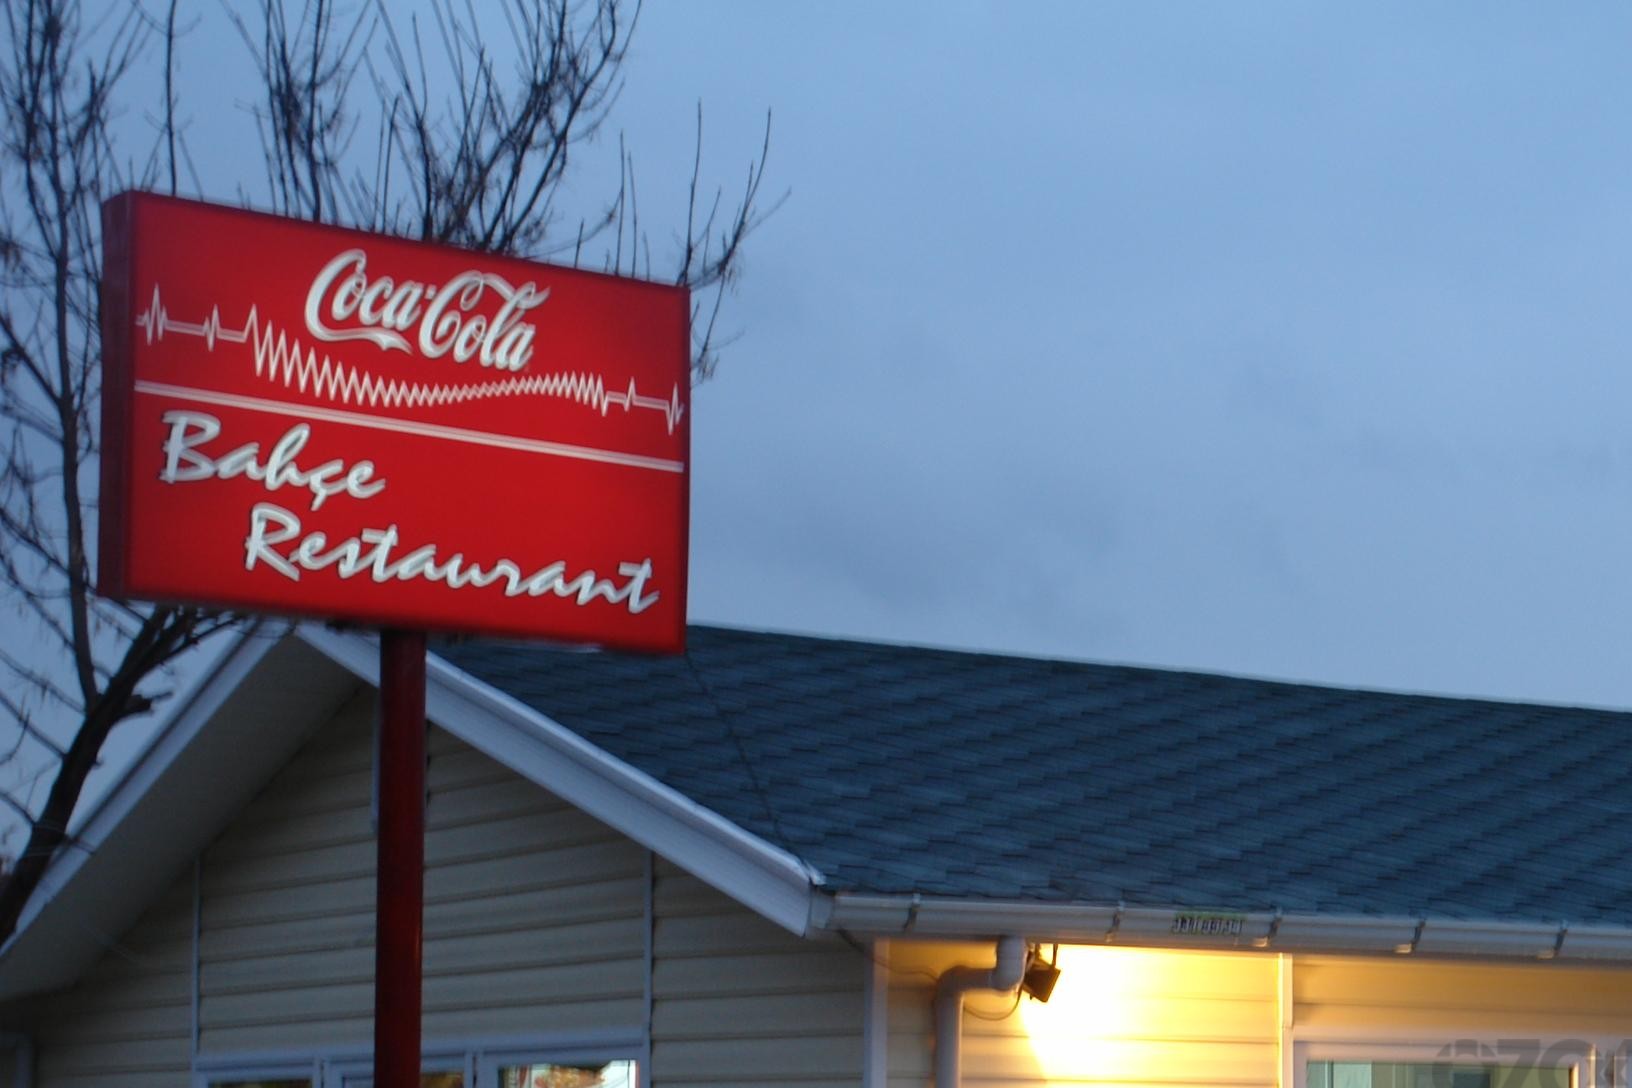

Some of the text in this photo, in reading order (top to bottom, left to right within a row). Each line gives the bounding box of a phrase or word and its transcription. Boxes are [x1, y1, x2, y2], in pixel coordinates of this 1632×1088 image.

[304, 248, 550, 372] Coca-Cola
[160, 409, 386, 511] Bahçe
[244, 502, 660, 613] Restaurant
